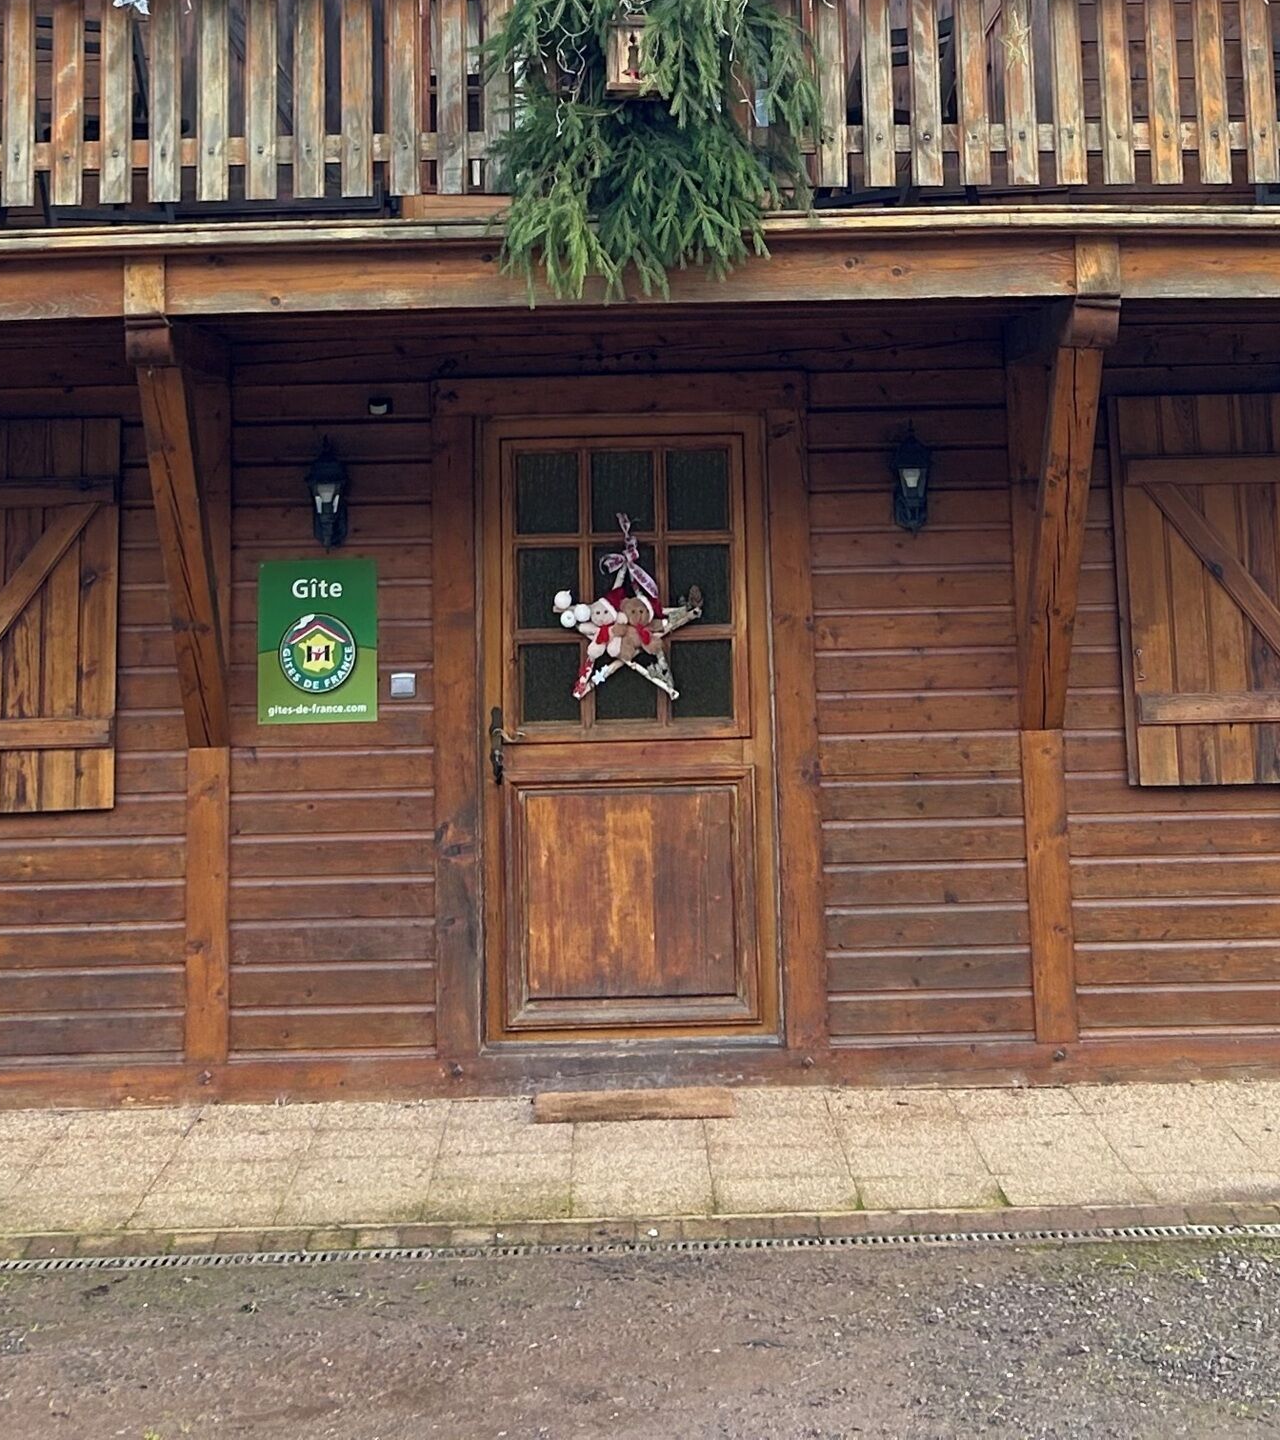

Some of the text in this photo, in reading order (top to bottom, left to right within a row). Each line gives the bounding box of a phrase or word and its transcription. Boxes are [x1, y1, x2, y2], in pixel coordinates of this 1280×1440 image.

[292, 578, 343, 599] Gîte
[303, 679, 320, 690] DE
[324, 646, 353, 688] FRANCE
[268, 703, 367, 717] gites-de-france.com
